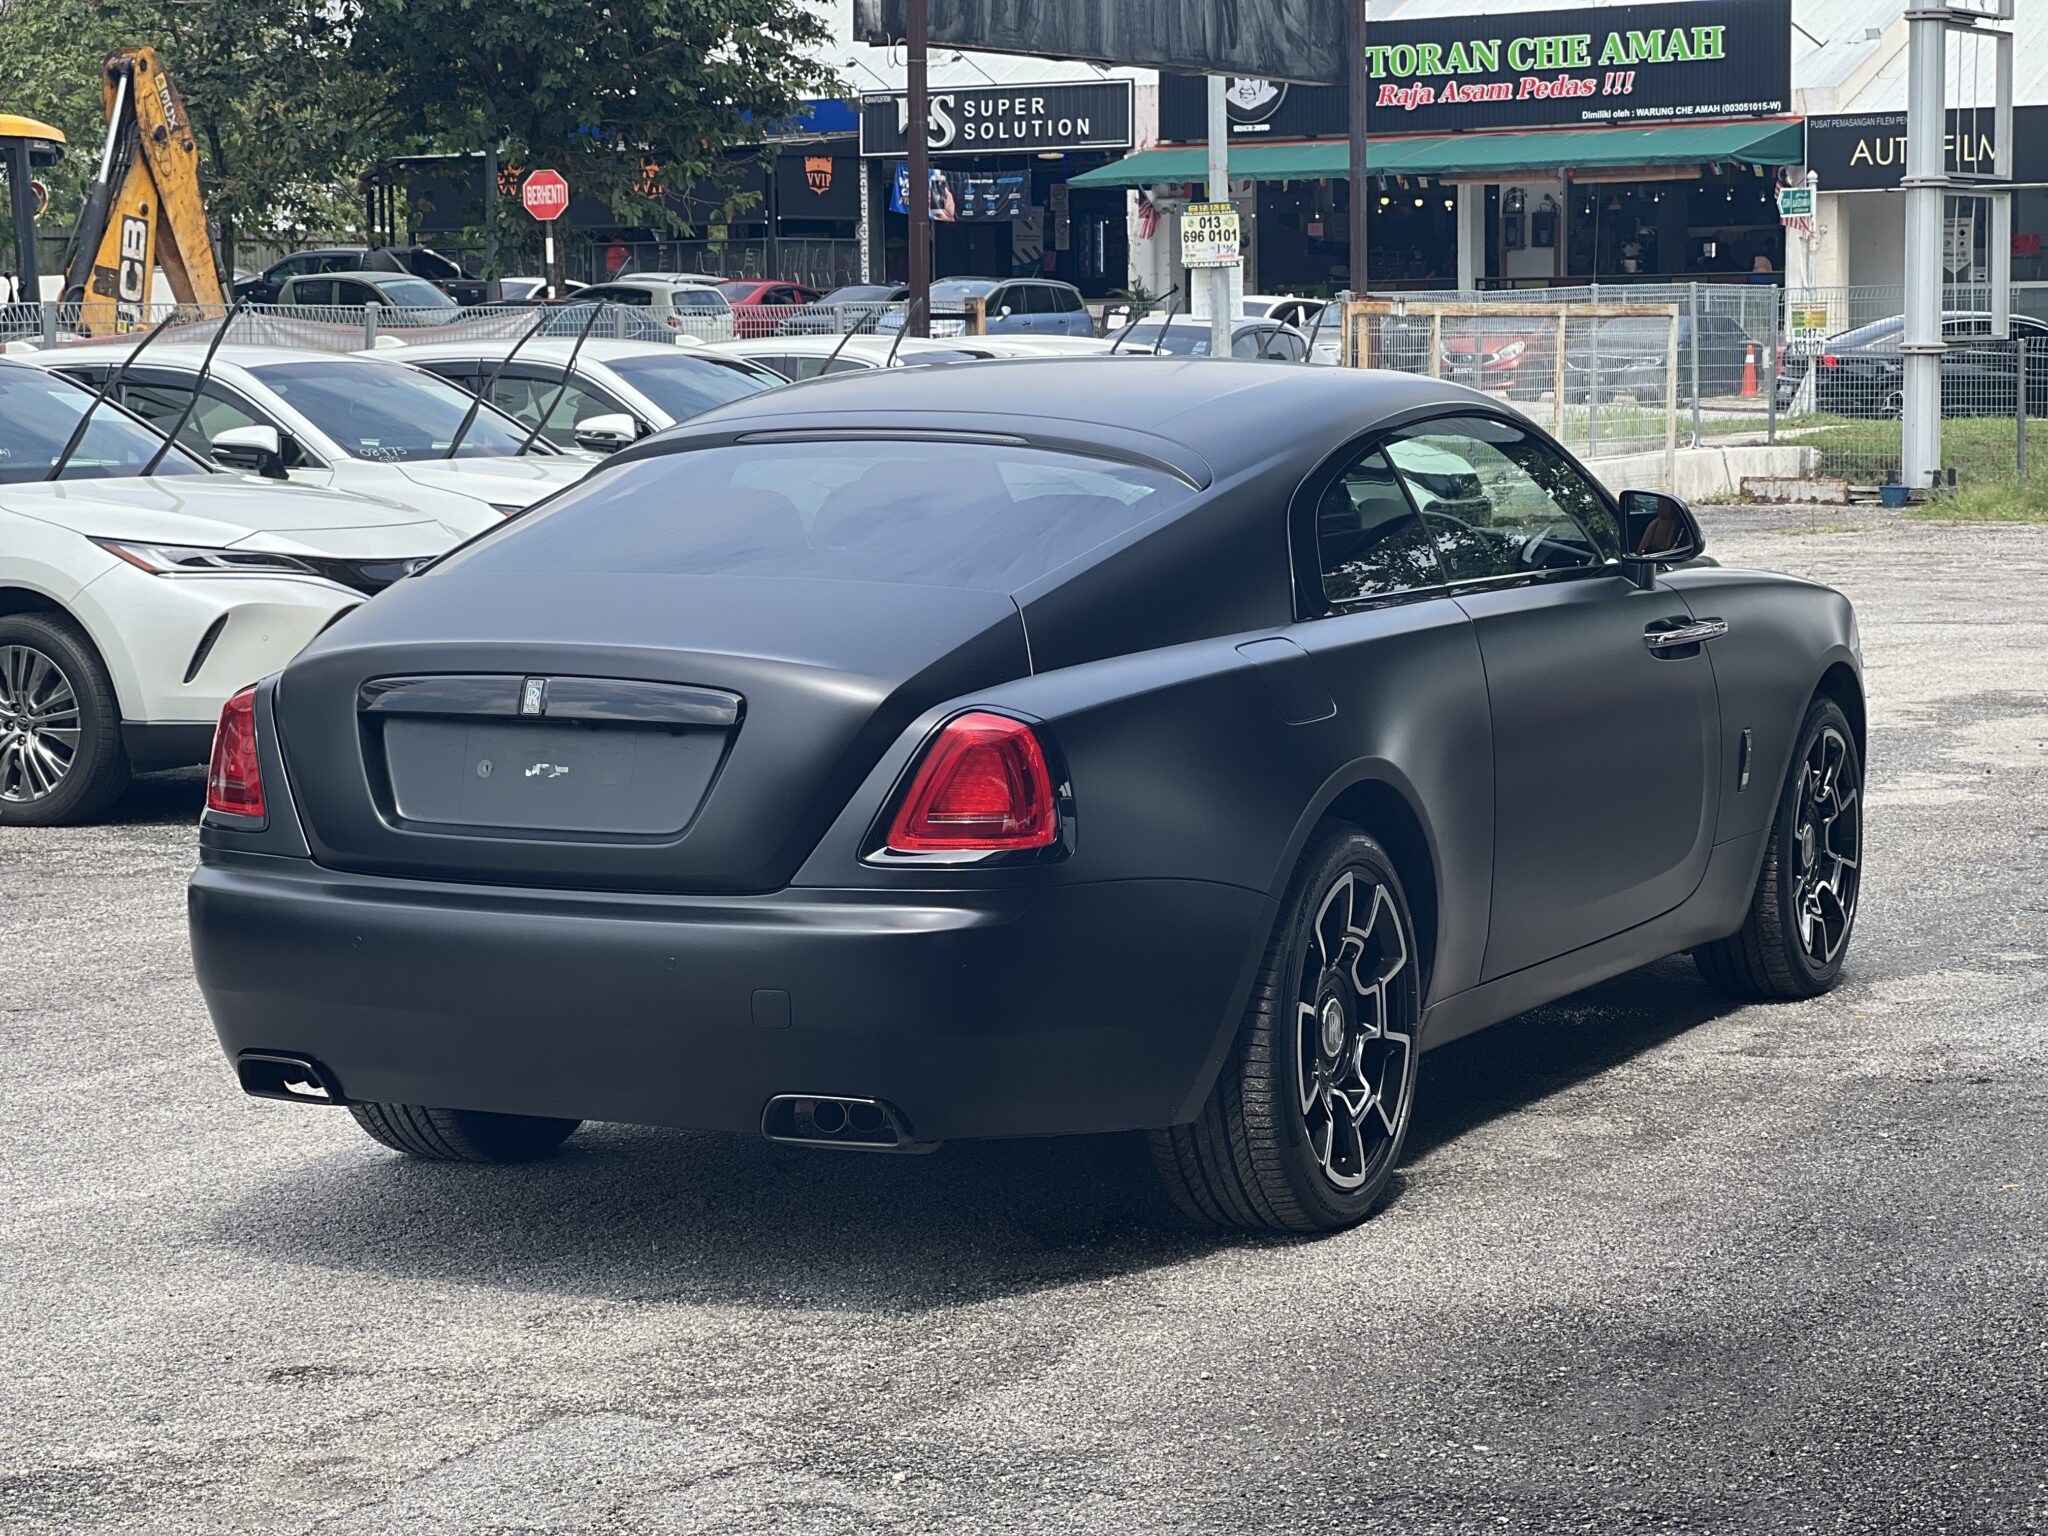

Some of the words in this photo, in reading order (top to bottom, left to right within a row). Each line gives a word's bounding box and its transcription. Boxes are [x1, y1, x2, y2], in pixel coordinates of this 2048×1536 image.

[1365, 40, 1501, 78] TORAN
[1507, 34, 1591, 71] CHE
[1598, 25, 1725, 66] AMAH
[1376, 81, 1434, 110] Raja
[1438, 80, 1512, 103] Asam
[1516, 74, 1596, 100] Pedas
[1602, 71, 1635, 95] !!!
[963, 97, 1045, 118] SUPER
[1582, 110, 1611, 119] Dimiliki
[1613, 109, 1630, 118] oleh
[1636, 107, 1674, 117] WARUNG
[1676, 106, 1693, 115] CHE
[1695, 105, 1720, 114] AMAH
[963, 118, 1090, 140] SOLUTION
[1810, 120, 1831, 129] PUSAT
[1832, 117, 1875, 128] PEMASANGAN
[1876, 116, 1894, 126] FILEM
[1850, 137, 1907, 166] AUT
[806, 173, 832, 187] VVIP
[527, 184, 564, 206] BERHENTI
[1200, 216, 1220, 229] 013
[1183, 230, 1205, 243] 696
[1209, 228, 1237, 242] 0101
[1184, 261, 1220, 269] TUKARAN
[118, 219, 147, 332] JCB
[1802, 328, 1817, 339] 017
